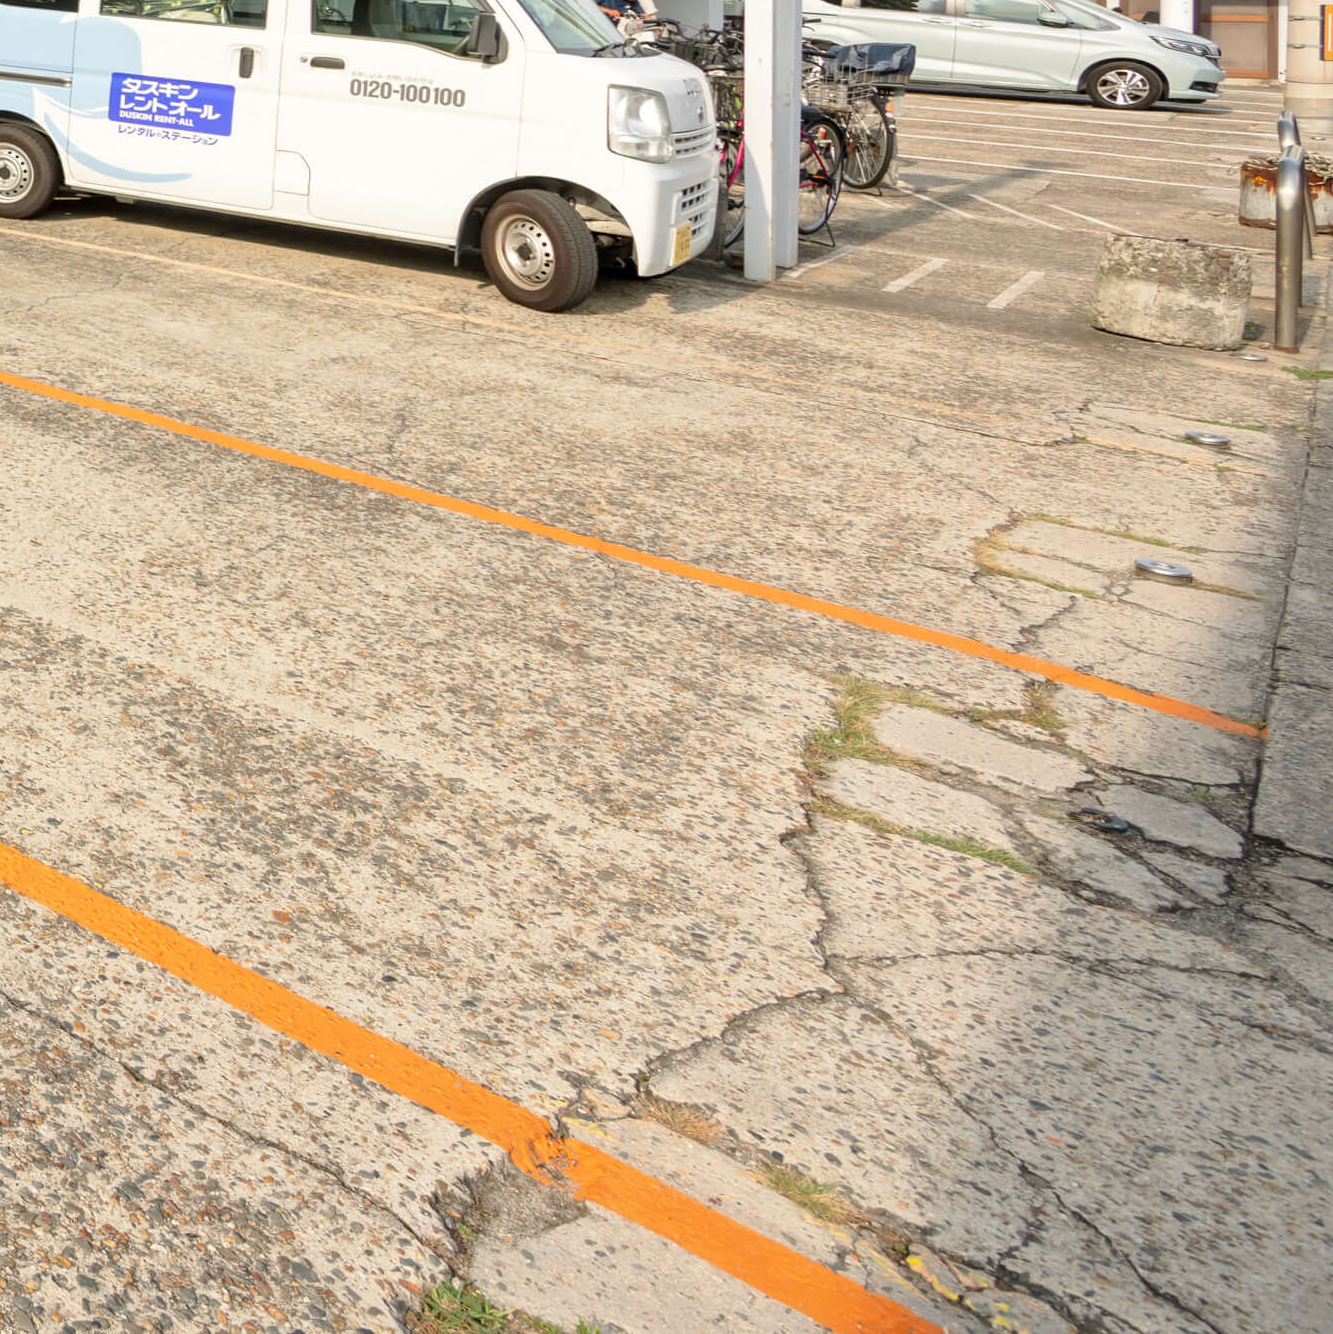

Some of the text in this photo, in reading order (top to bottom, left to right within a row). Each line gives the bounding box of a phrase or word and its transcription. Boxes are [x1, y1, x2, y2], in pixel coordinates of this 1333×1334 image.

[120, 77, 199, 100] ダスキン
[119, 94, 222, 121] レントオール
[119, 109, 195, 128] DUSKIN RENT-ALL
